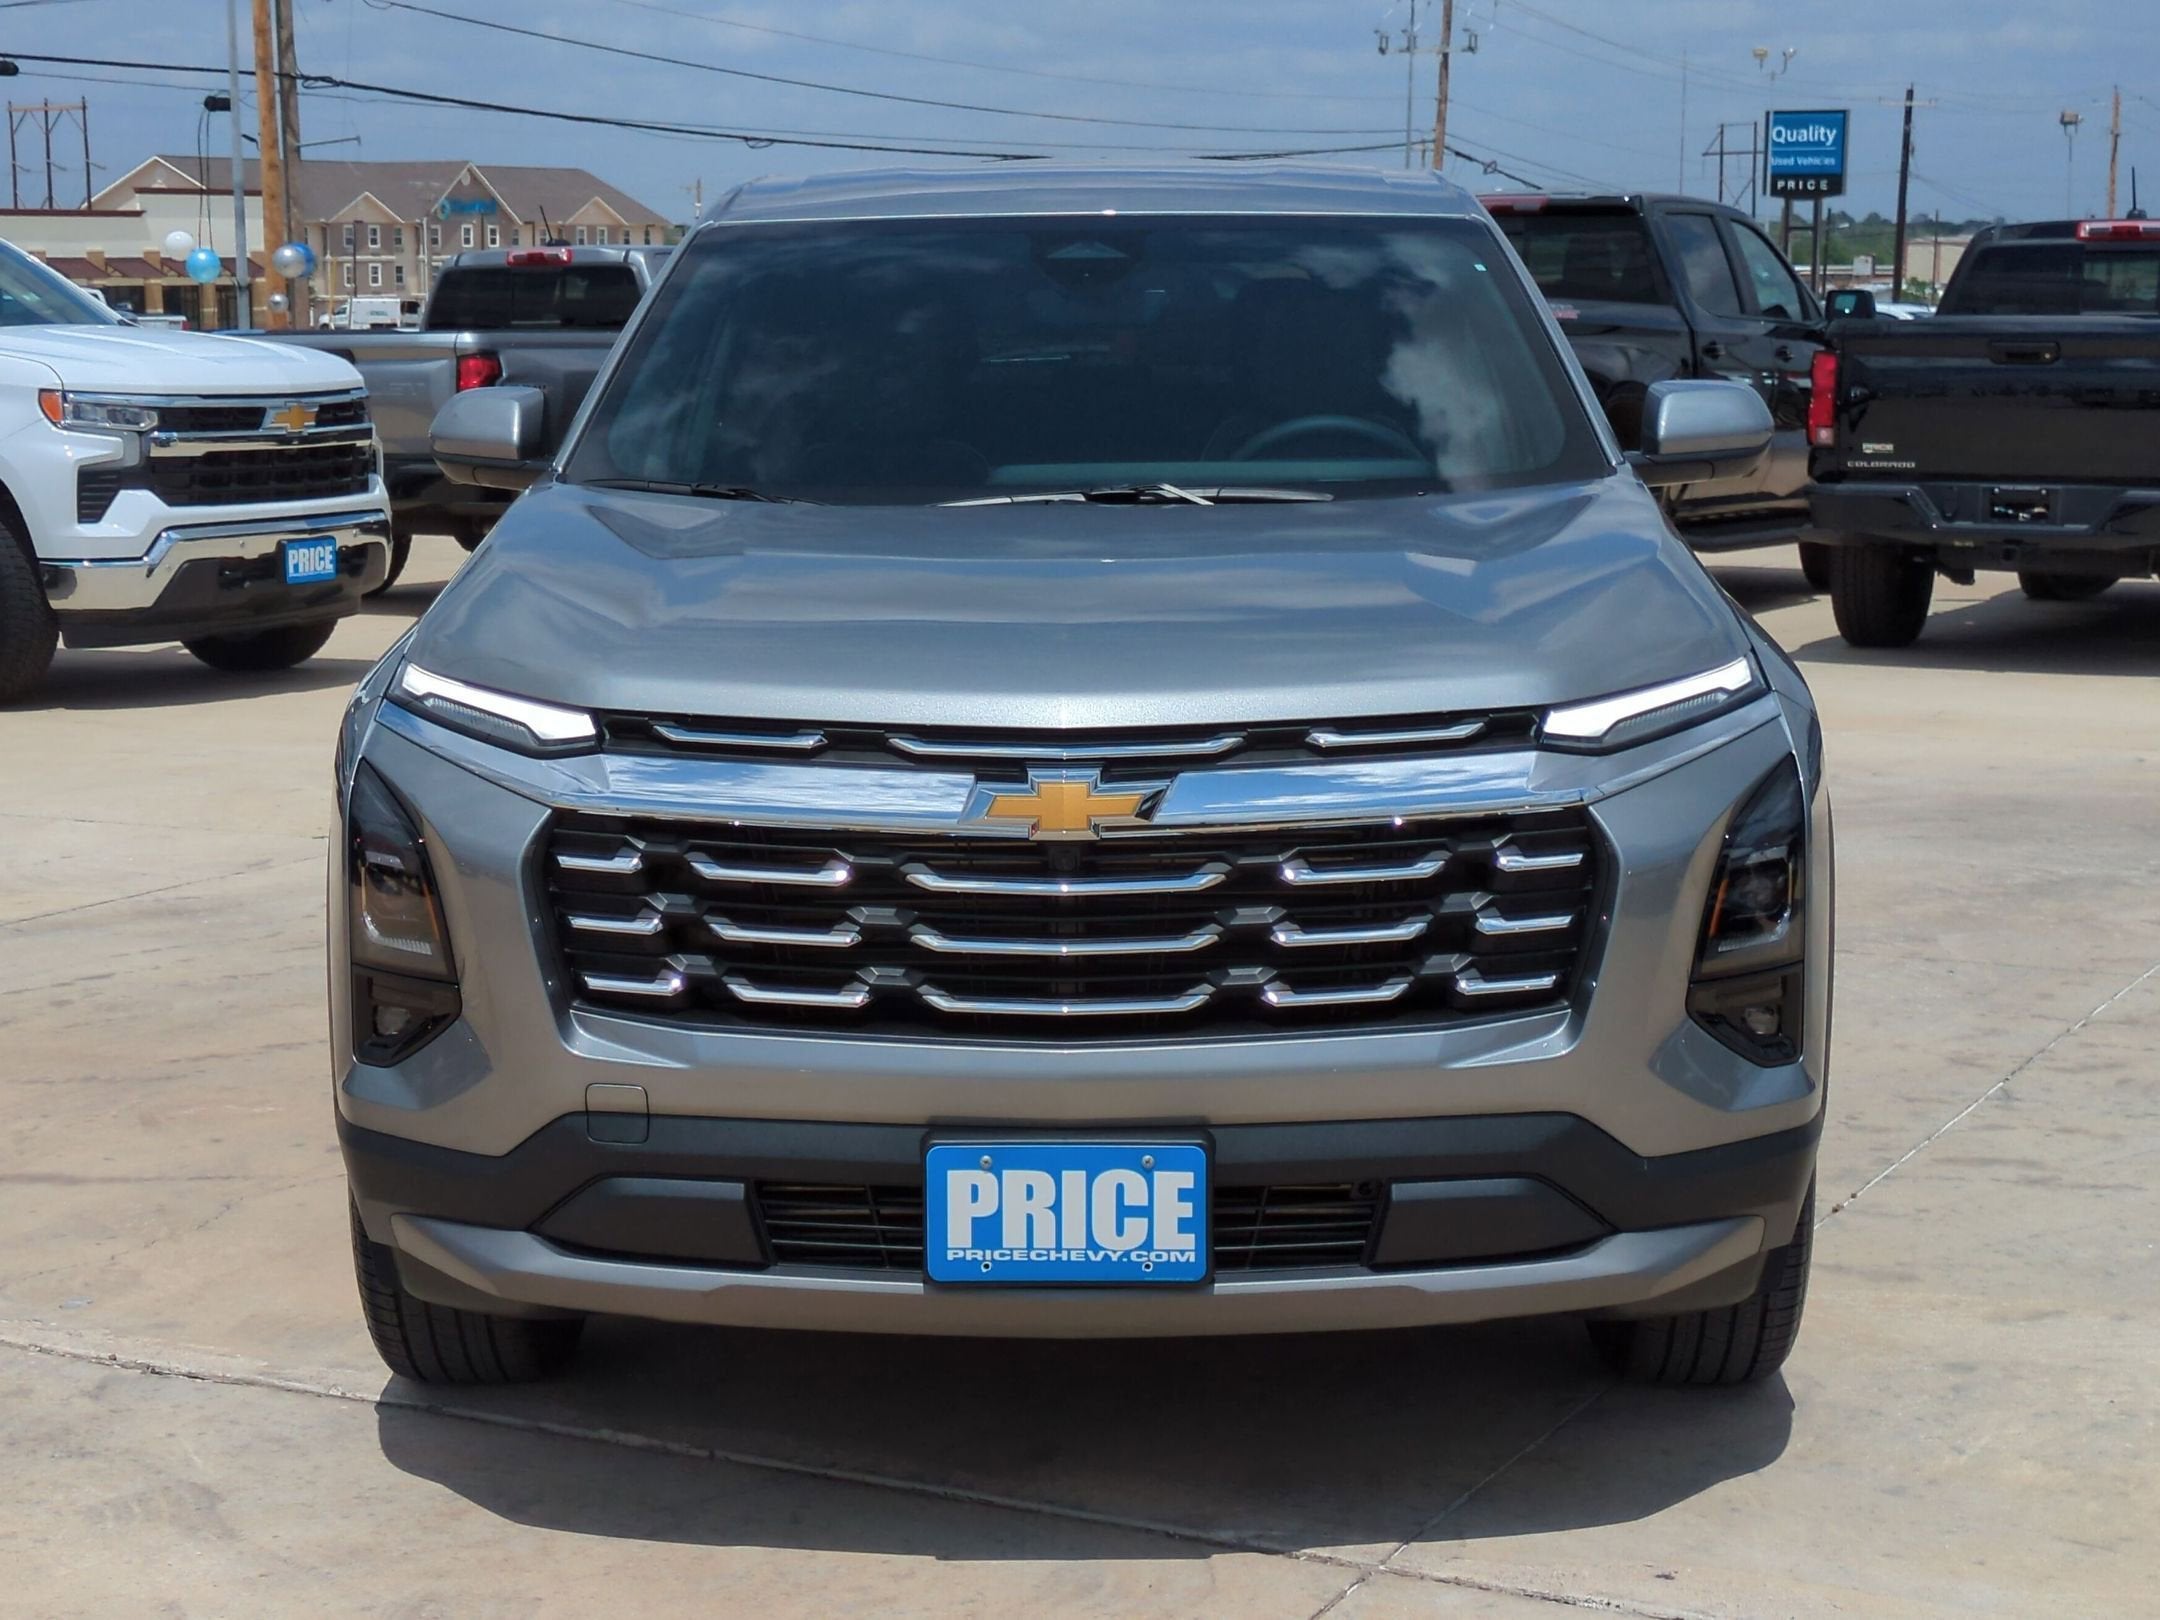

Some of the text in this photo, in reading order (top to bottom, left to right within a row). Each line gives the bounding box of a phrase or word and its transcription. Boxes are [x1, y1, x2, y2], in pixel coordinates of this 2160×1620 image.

[1772, 125, 1836, 146] Quality
[1772, 156, 1794, 166] Used
[1777, 180, 1828, 190] PRICE
[288, 546, 334, 574] PRICE
[947, 1169, 1195, 1251] PRICE
[947, 1249, 1195, 1263] PRICECHEVY.COM
